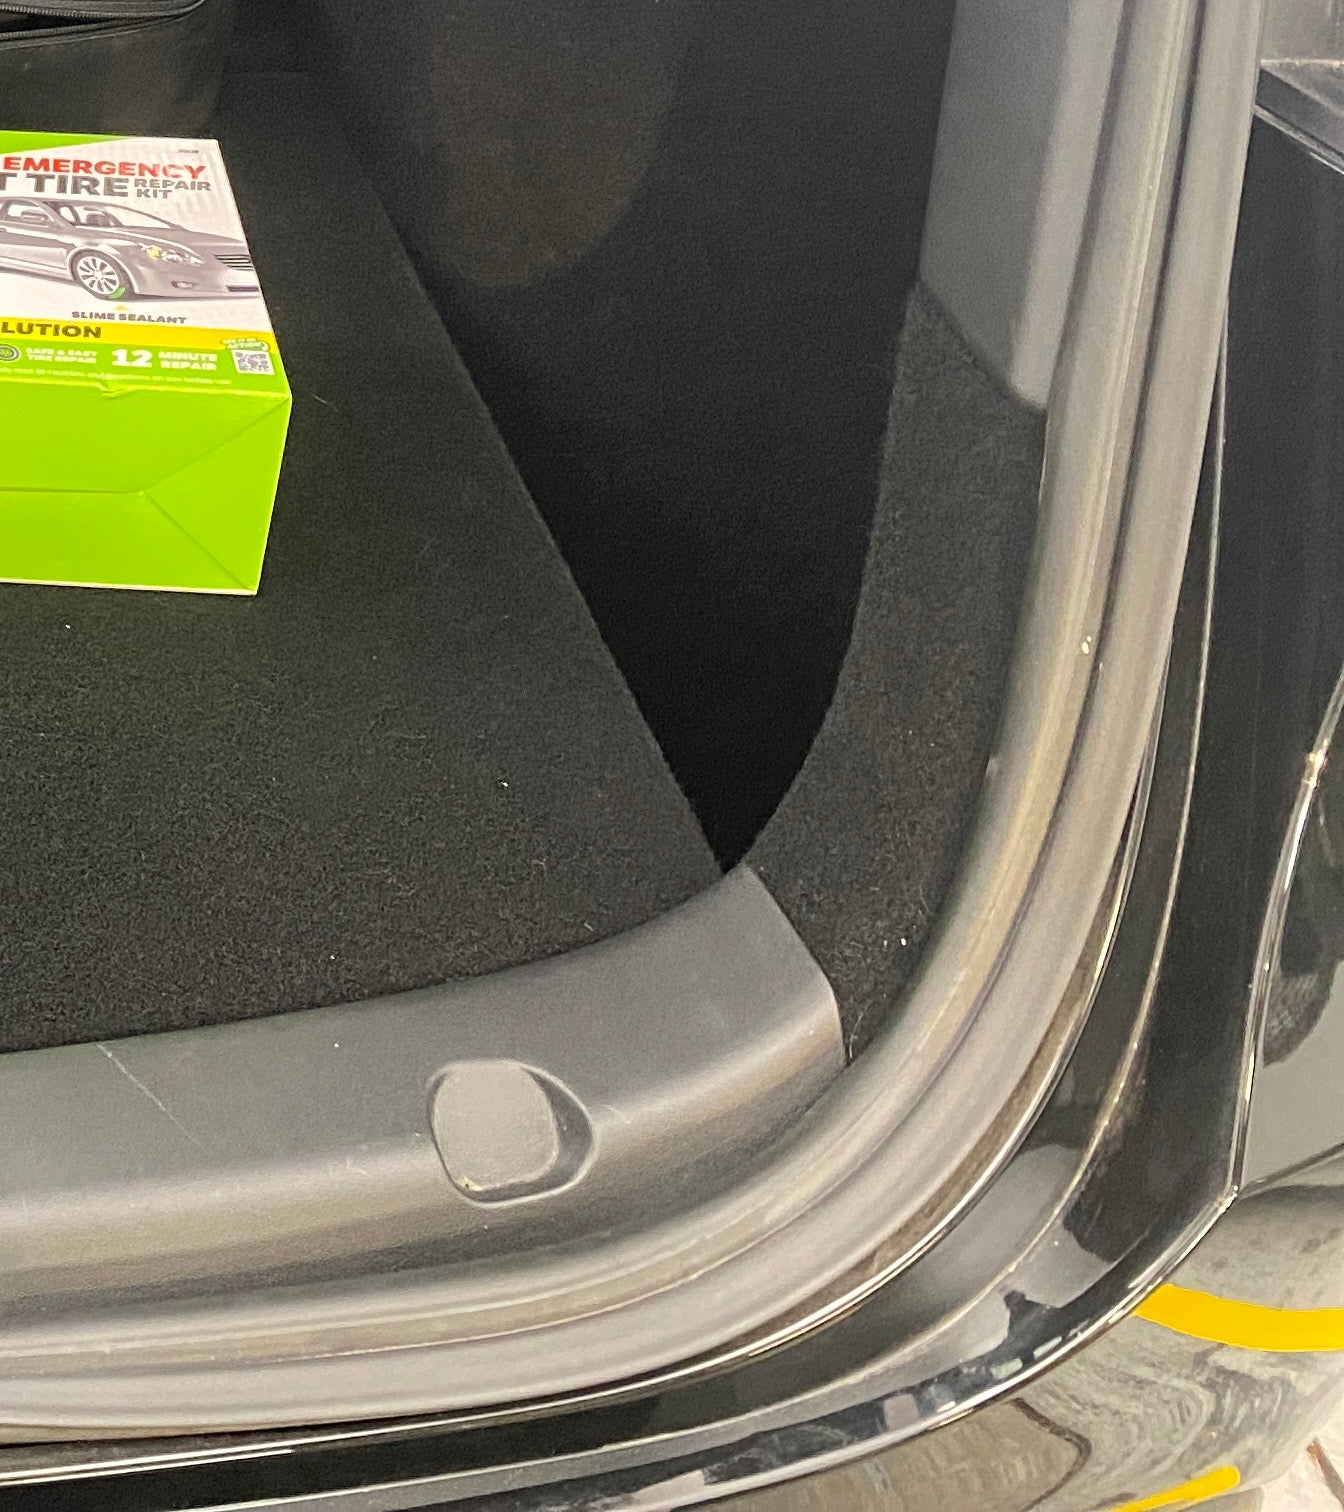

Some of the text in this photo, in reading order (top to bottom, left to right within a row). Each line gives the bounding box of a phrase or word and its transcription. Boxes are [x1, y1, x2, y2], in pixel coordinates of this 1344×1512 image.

[3, 156, 206, 180] EMERGENCY
[26, 173, 129, 198] TIRE
[134, 178, 211, 191] REPAIR
[136, 188, 173, 199] KIT
[71, 311, 187, 324] SLIME SEALANT
[111, 348, 154, 368] 12
[158, 350, 218, 362] MINUTE
[161, 360, 217, 371] REPAIR
